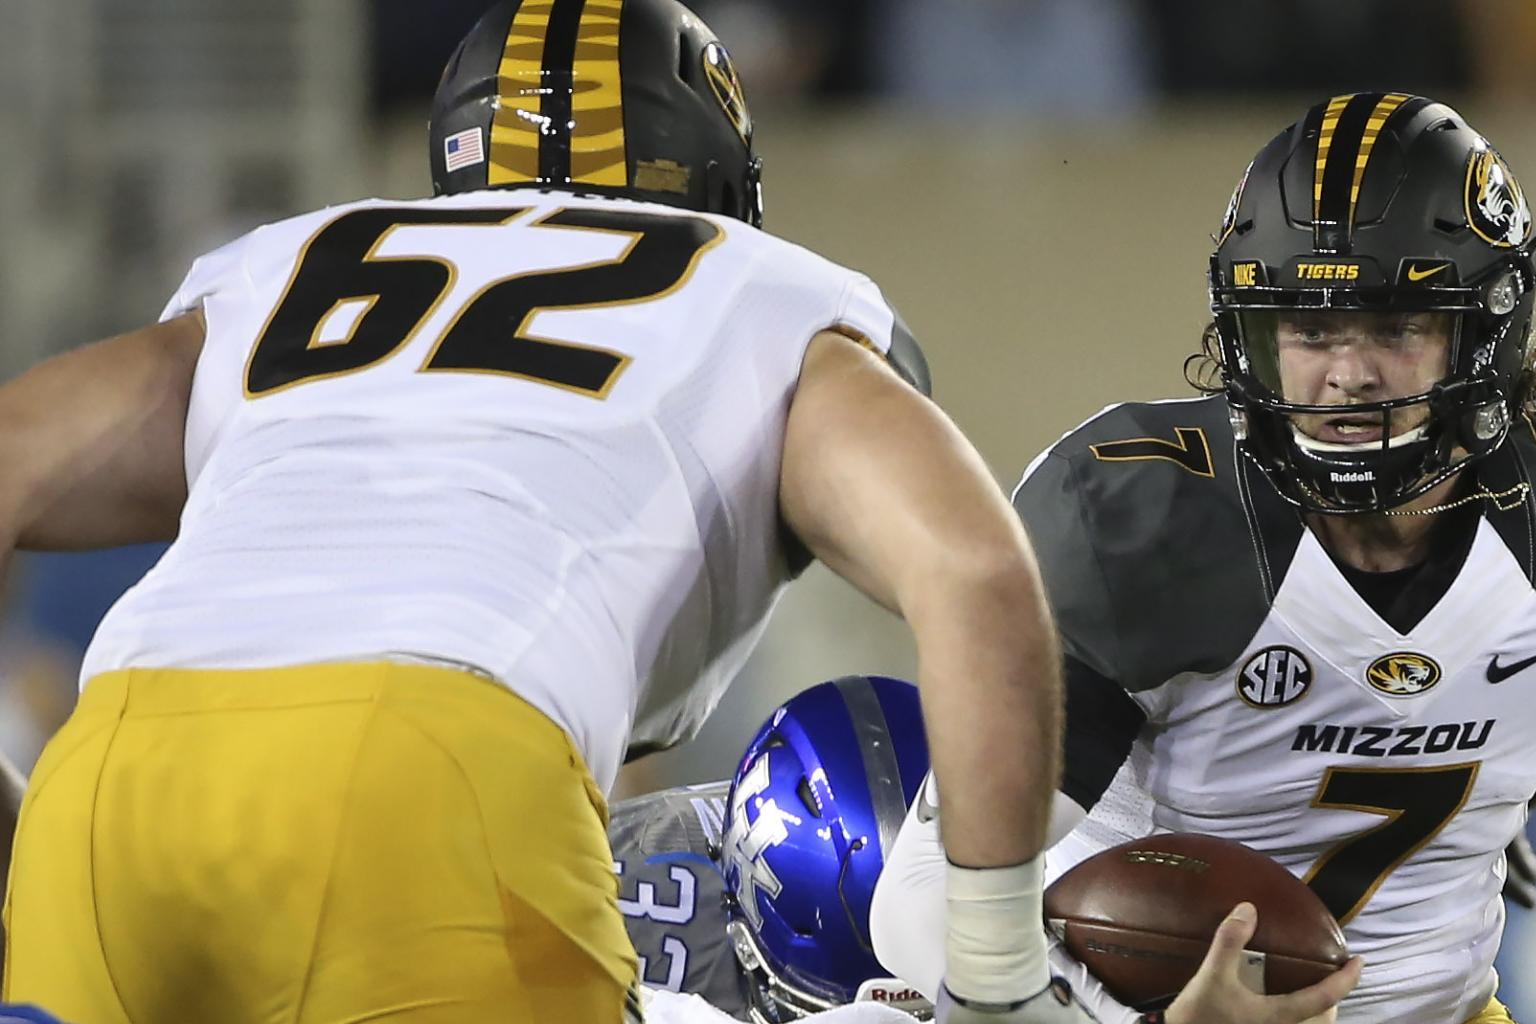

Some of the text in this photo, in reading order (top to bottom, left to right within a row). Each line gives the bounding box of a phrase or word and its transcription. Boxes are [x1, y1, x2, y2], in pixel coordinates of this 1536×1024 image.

[1233, 263, 1257, 286] NIKE
[1296, 263, 1360, 280] TIGERS
[243, 206, 727, 400] 62
[1089, 427, 1215, 478] 7
[1330, 471, 1374, 482] Riddell
[1243, 650, 1306, 704] SEC
[1291, 719, 1497, 757] MIZZOU
[1309, 760, 1482, 929] 7
